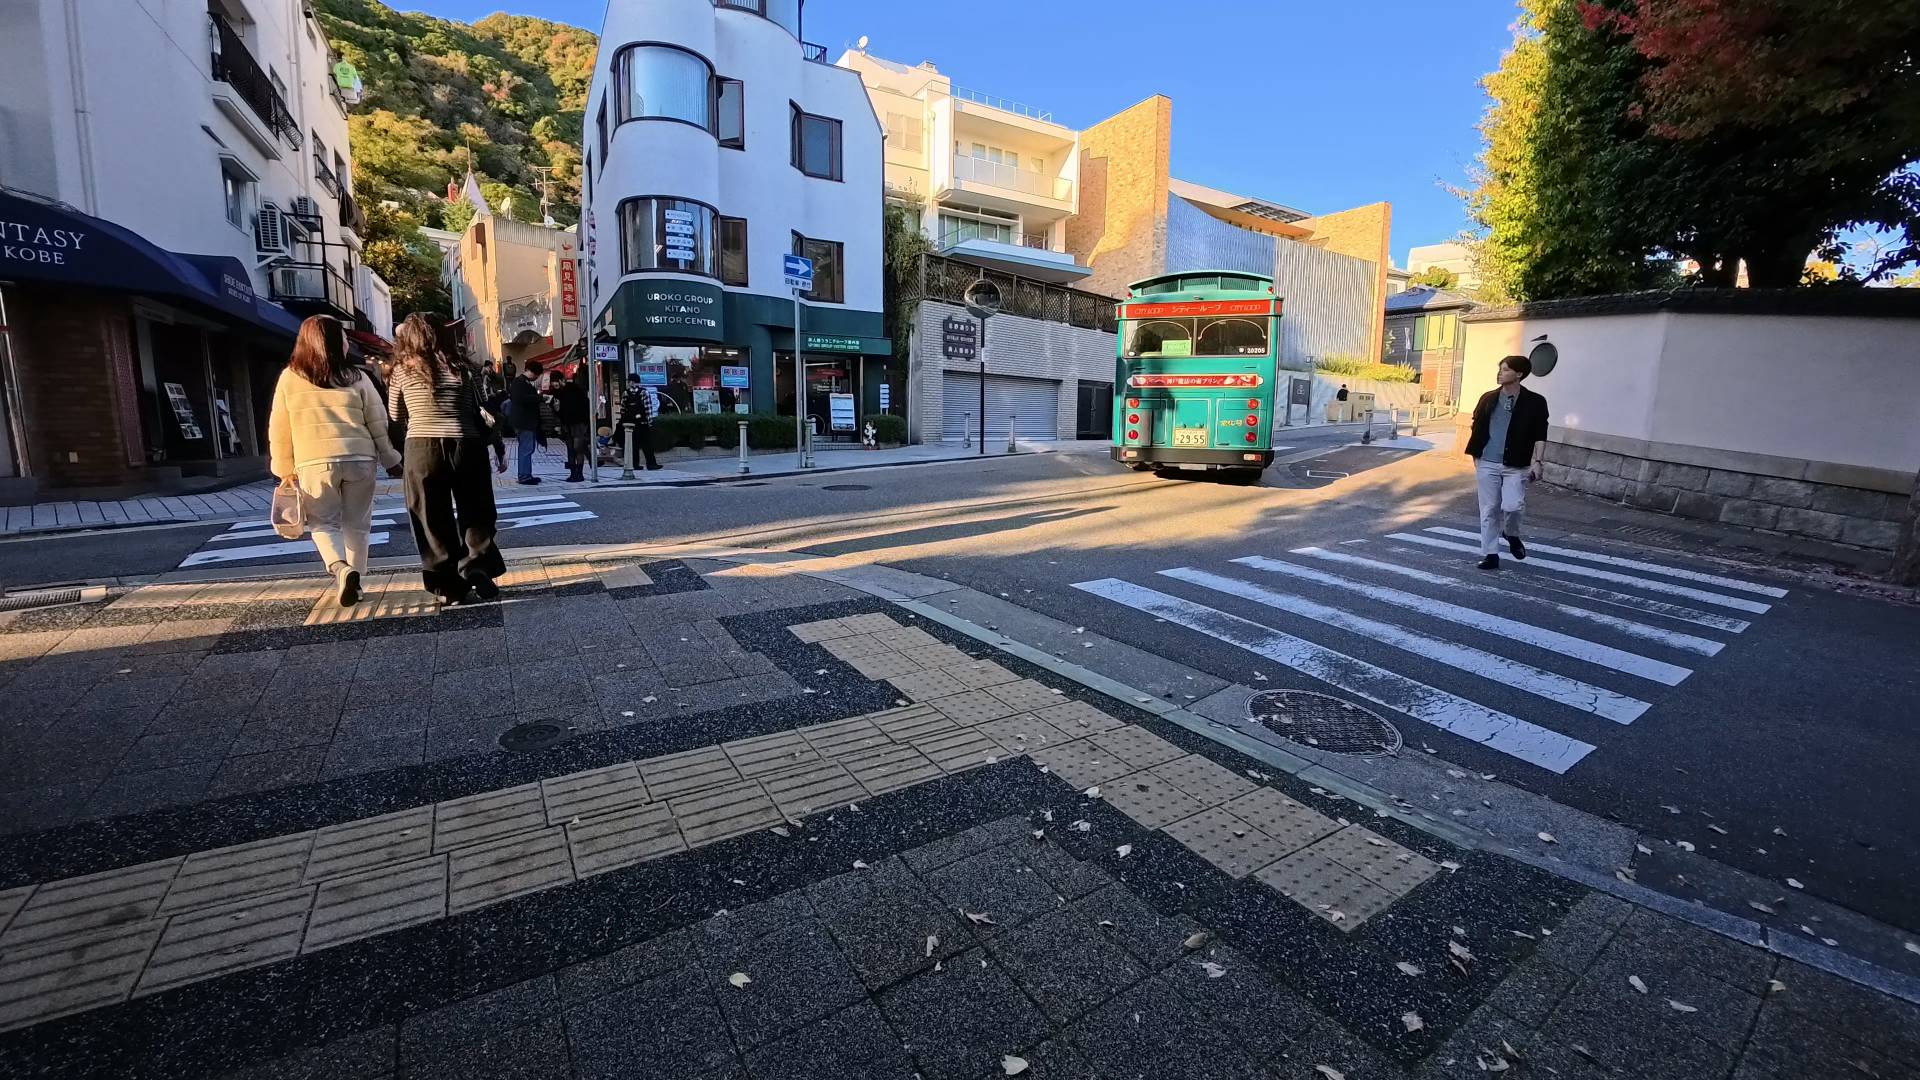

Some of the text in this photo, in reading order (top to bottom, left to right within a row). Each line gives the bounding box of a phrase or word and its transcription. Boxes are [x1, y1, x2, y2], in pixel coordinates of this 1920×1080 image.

[4, 245, 65, 265] KOBE
[647, 293, 713, 304] UROKO GROUP
[664, 305, 700, 314] KITANO
[645, 315, 716, 327] VISITOR CENTER
